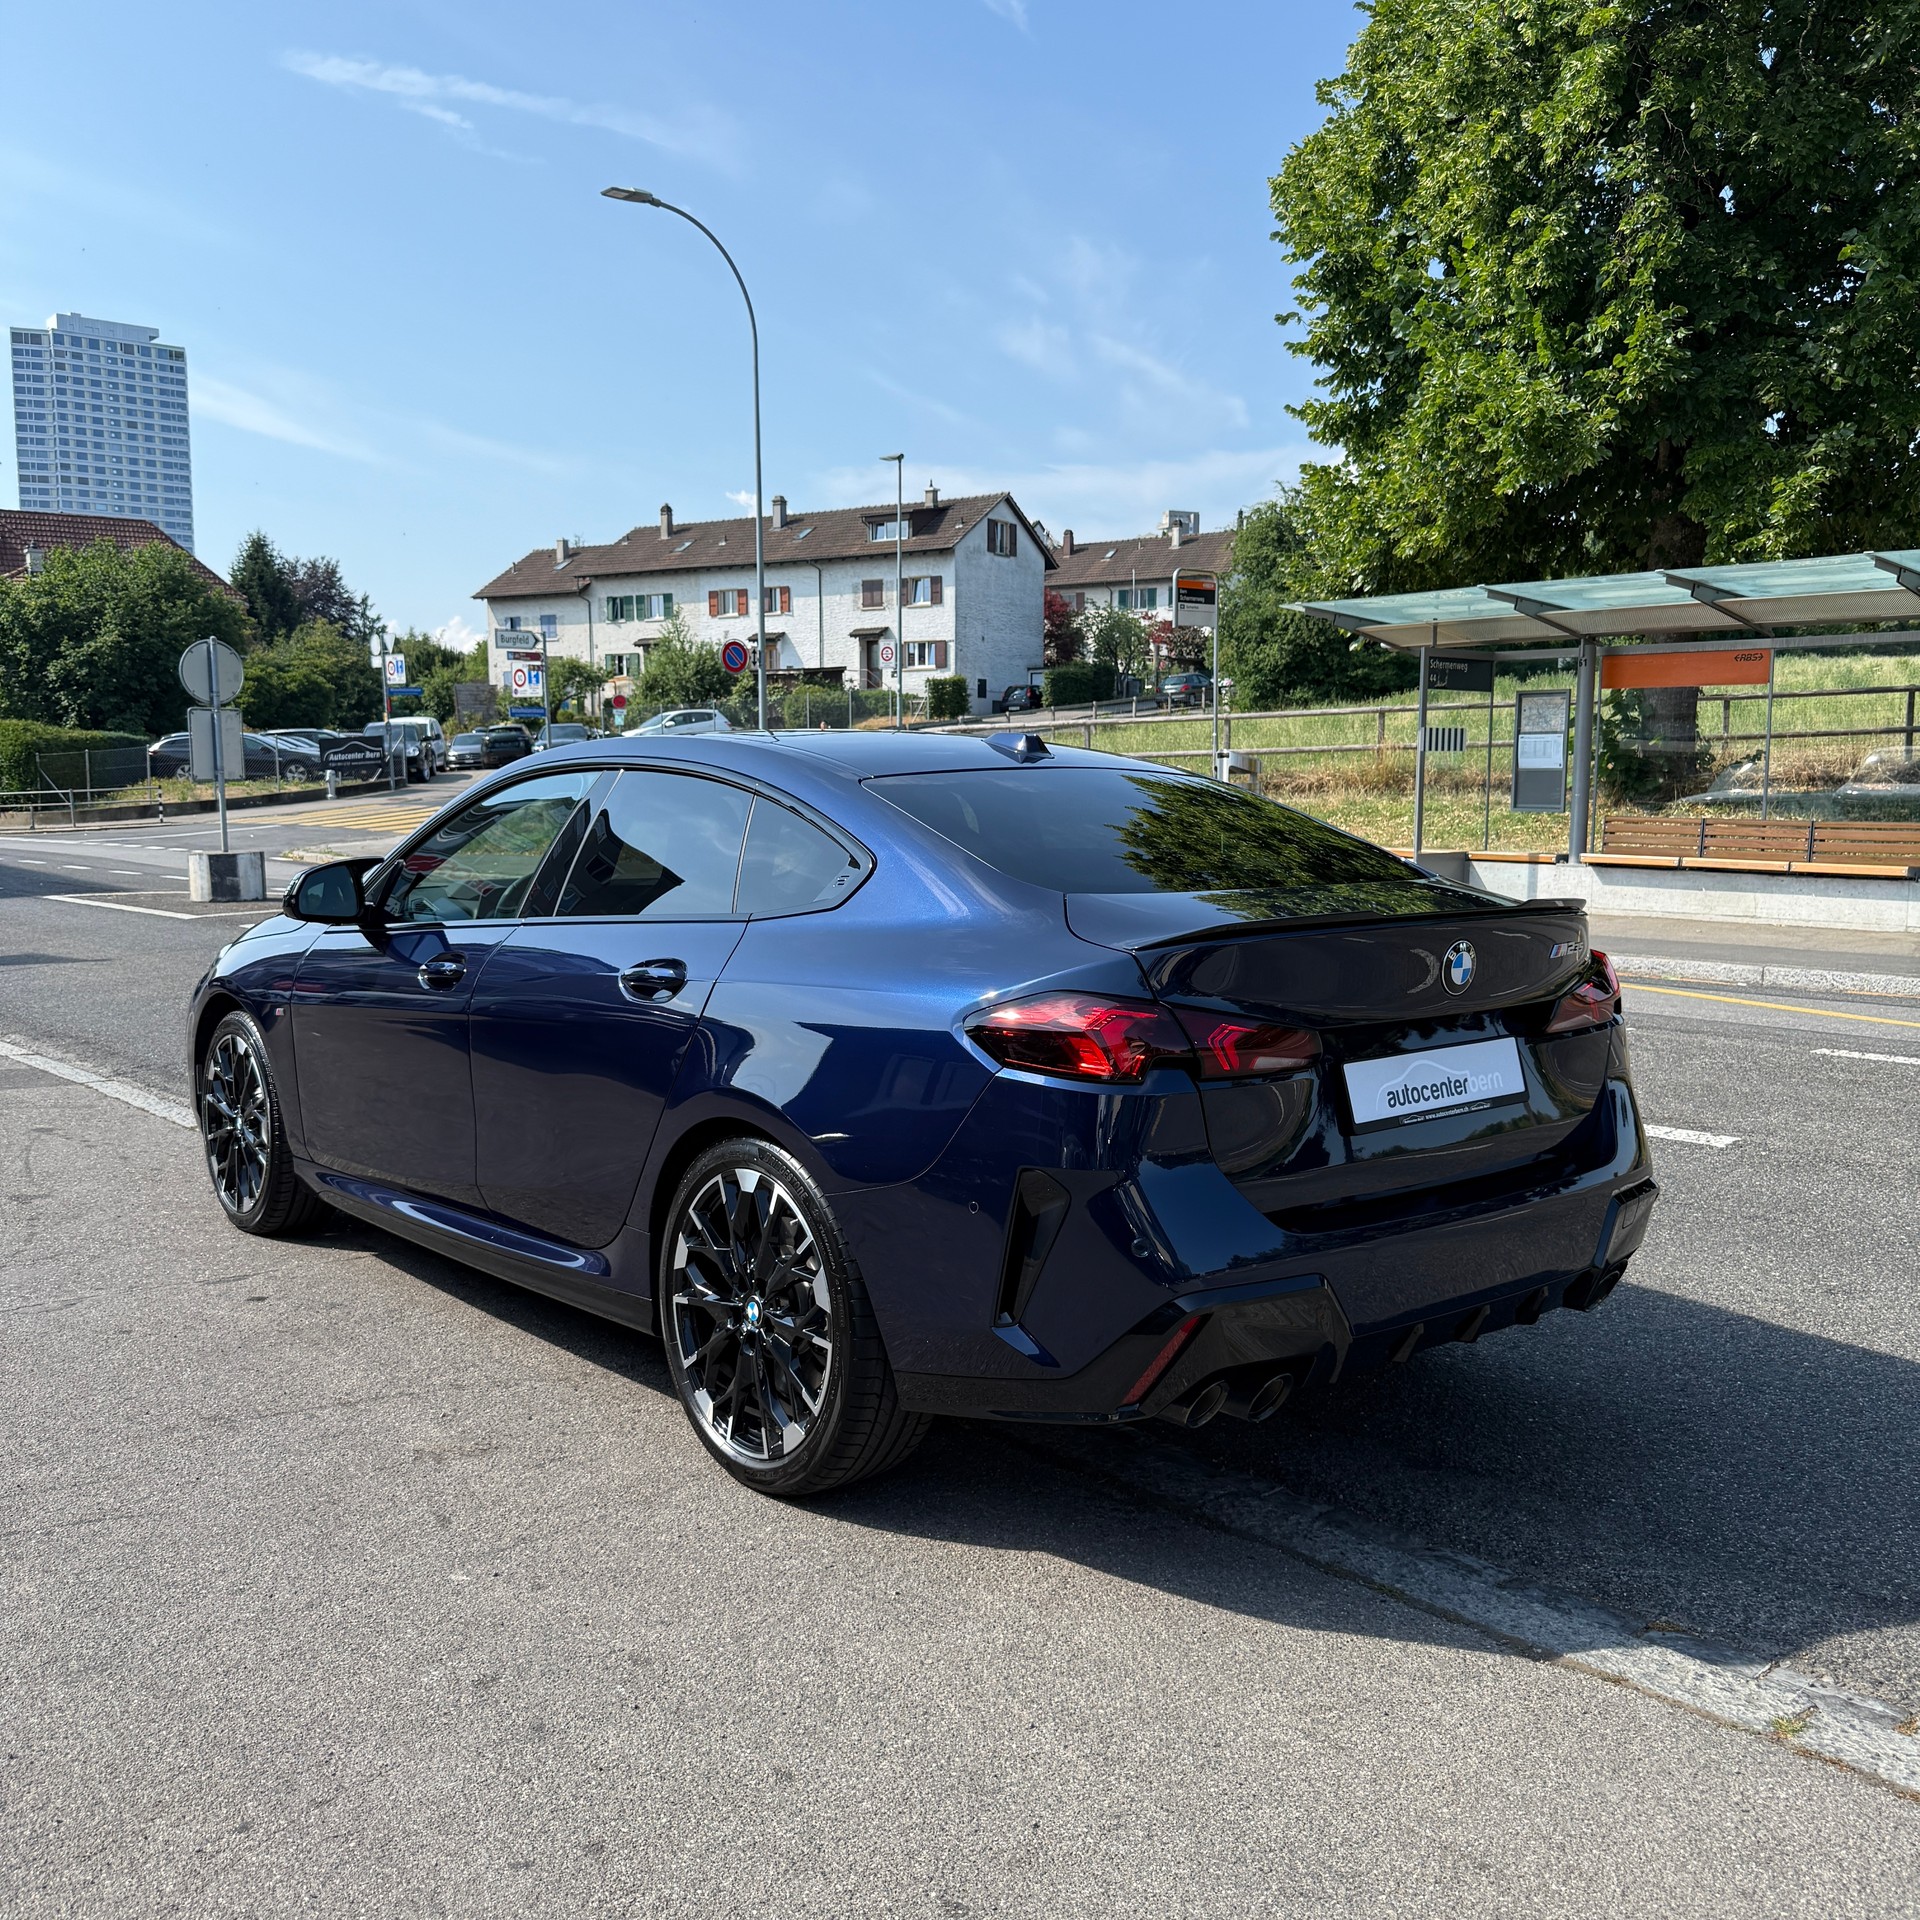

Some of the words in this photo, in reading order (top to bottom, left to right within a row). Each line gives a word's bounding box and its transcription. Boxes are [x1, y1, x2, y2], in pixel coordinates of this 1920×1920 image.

[500, 634, 530, 646] Burgfeld
[1430, 659, 1468, 672] Schermenweg
[329, 752, 364, 761] Autocenter
[365, 750, 381, 759] Bern
[1448, 942, 1476, 961] BMW
[763, 1152, 810, 1200] BRIDGESTONE
